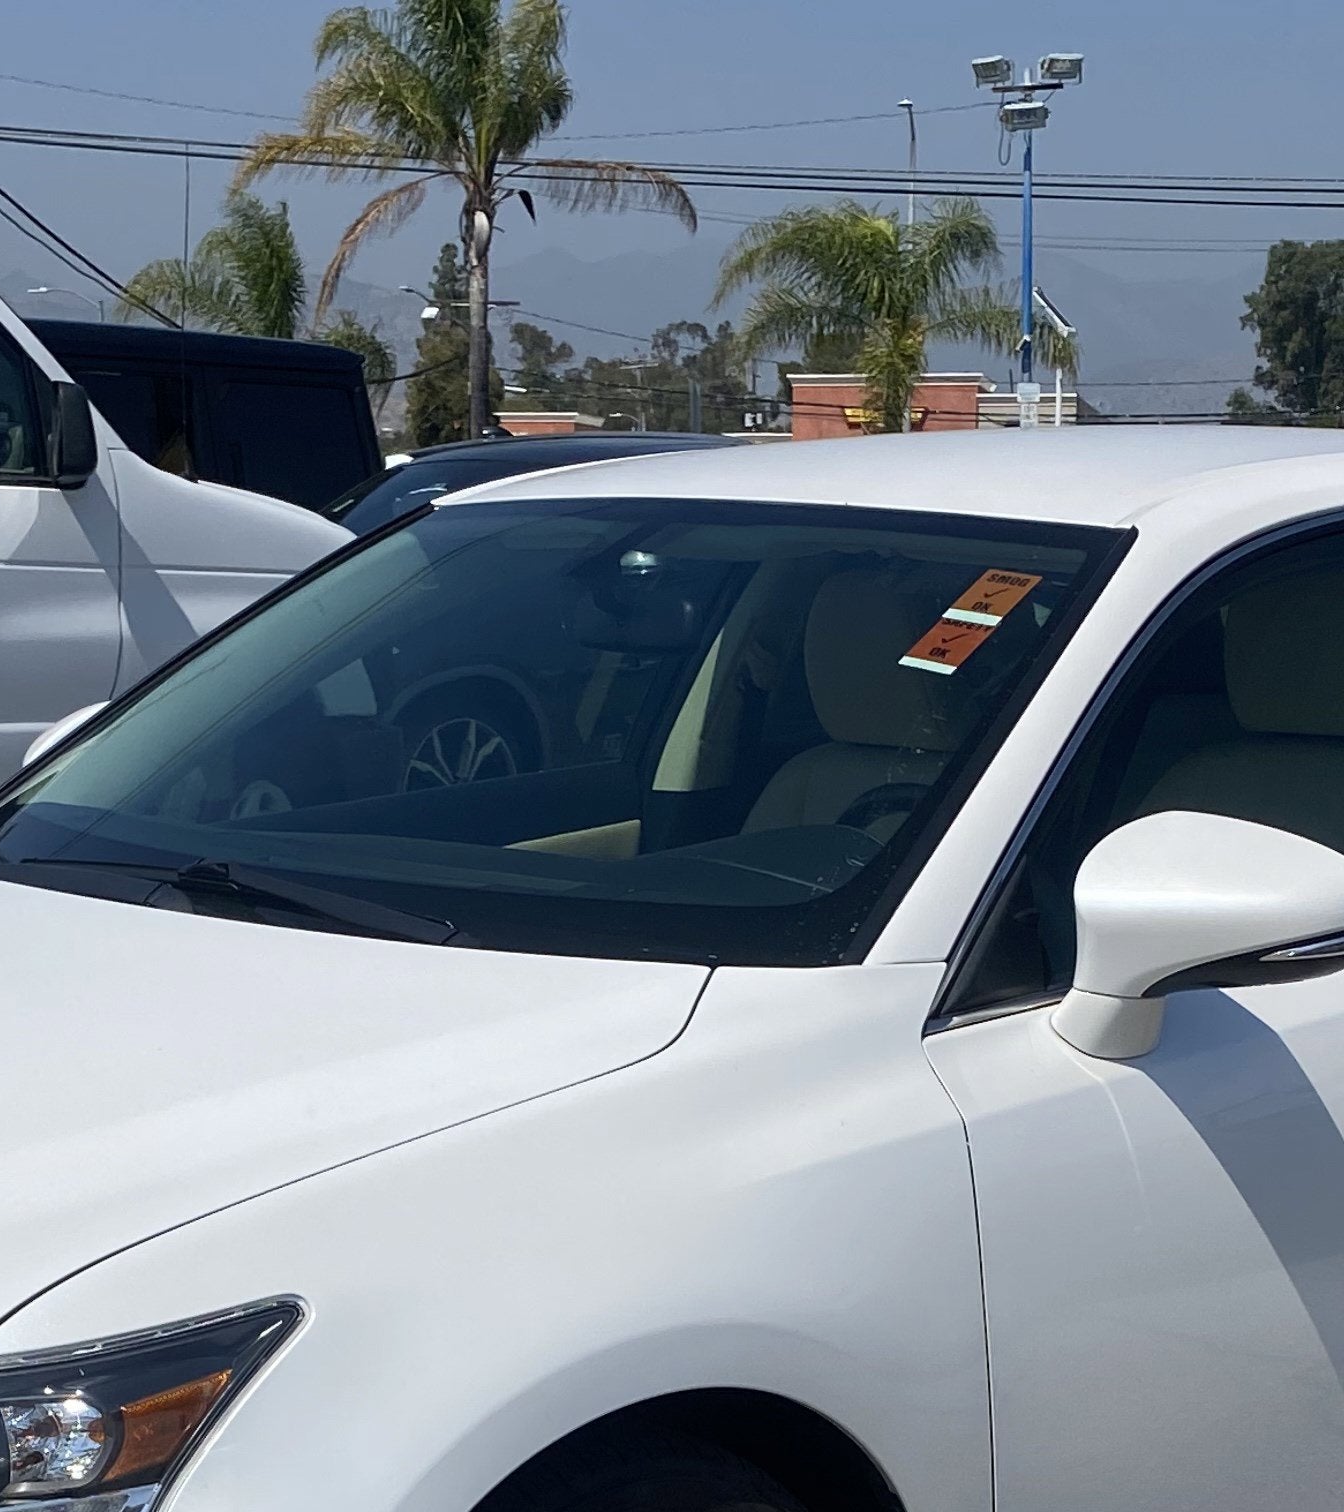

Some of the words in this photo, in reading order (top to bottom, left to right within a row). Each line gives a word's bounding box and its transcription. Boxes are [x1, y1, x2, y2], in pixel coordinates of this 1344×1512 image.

[987, 573, 1031, 588] SMOG
[971, 601, 993, 613] OK
[928, 647, 951, 659] OK
